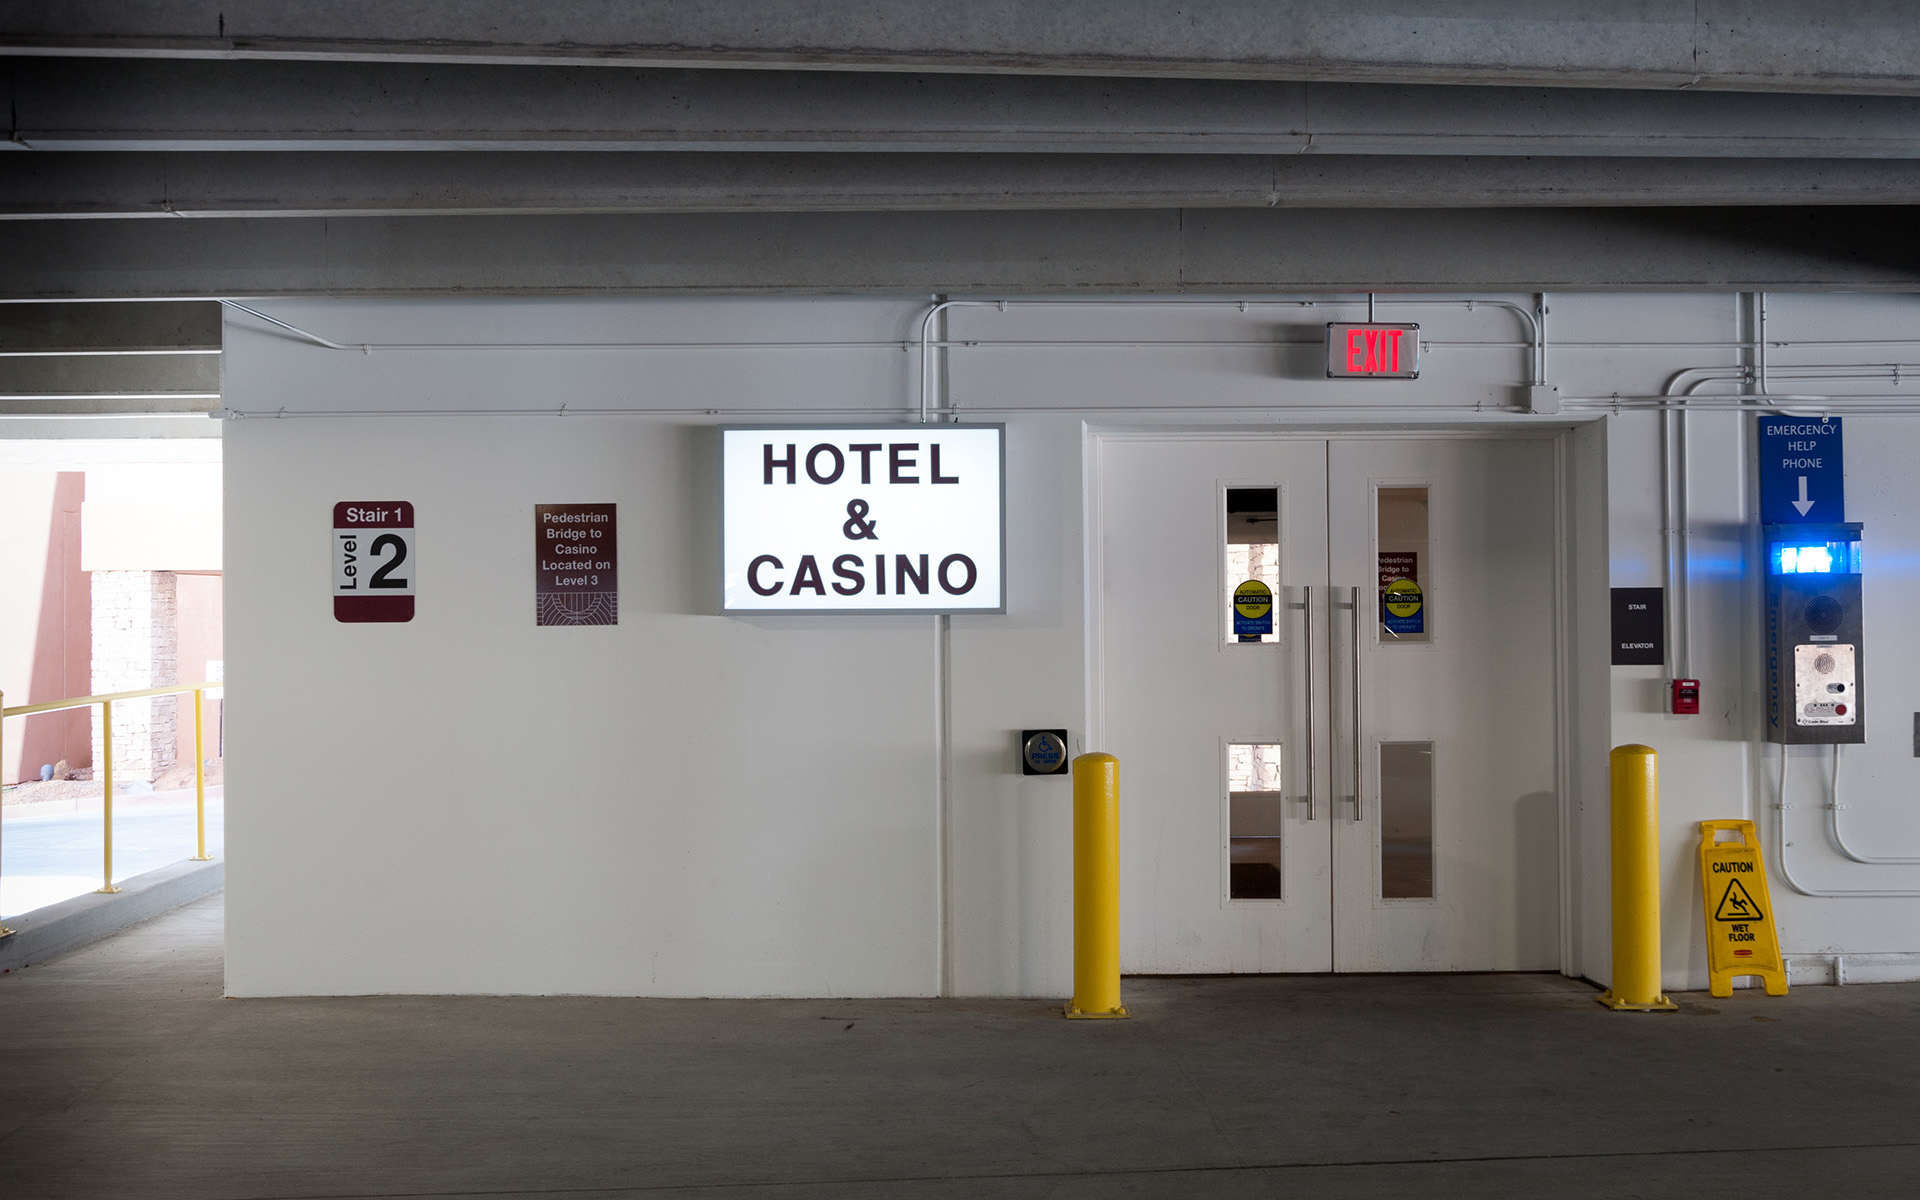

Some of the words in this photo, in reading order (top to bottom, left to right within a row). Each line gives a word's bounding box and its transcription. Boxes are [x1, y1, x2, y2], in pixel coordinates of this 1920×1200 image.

[1346, 330, 1403, 372] EXIT
[1767, 424, 1837, 436] EMERGENCY
[1788, 441, 1817, 452] HELP
[763, 443, 959, 485] HOTEL
[1783, 458, 1823, 469] PHONE
[346, 507, 388, 523] Stair
[395, 508, 403, 522] 1
[543, 513, 609, 524] Pedestrian
[842, 498, 879, 540] &
[546, 528, 587, 541] Bridge
[589, 529, 602, 539] to
[555, 544, 598, 555] Casino
[340, 534, 358, 590] Level
[369, 533, 408, 589] 2
[542, 560, 592, 571] Located
[595, 562, 611, 571] on
[556, 575, 588, 586] Level
[591, 575, 598, 586] 3
[747, 553, 977, 596] CASINO
[1770, 593, 1779, 729] Emergency
[1713, 862, 1754, 873] CAUTION
[1732, 924, 1749, 933] WET
[1728, 933, 1755, 942] FLOOR
